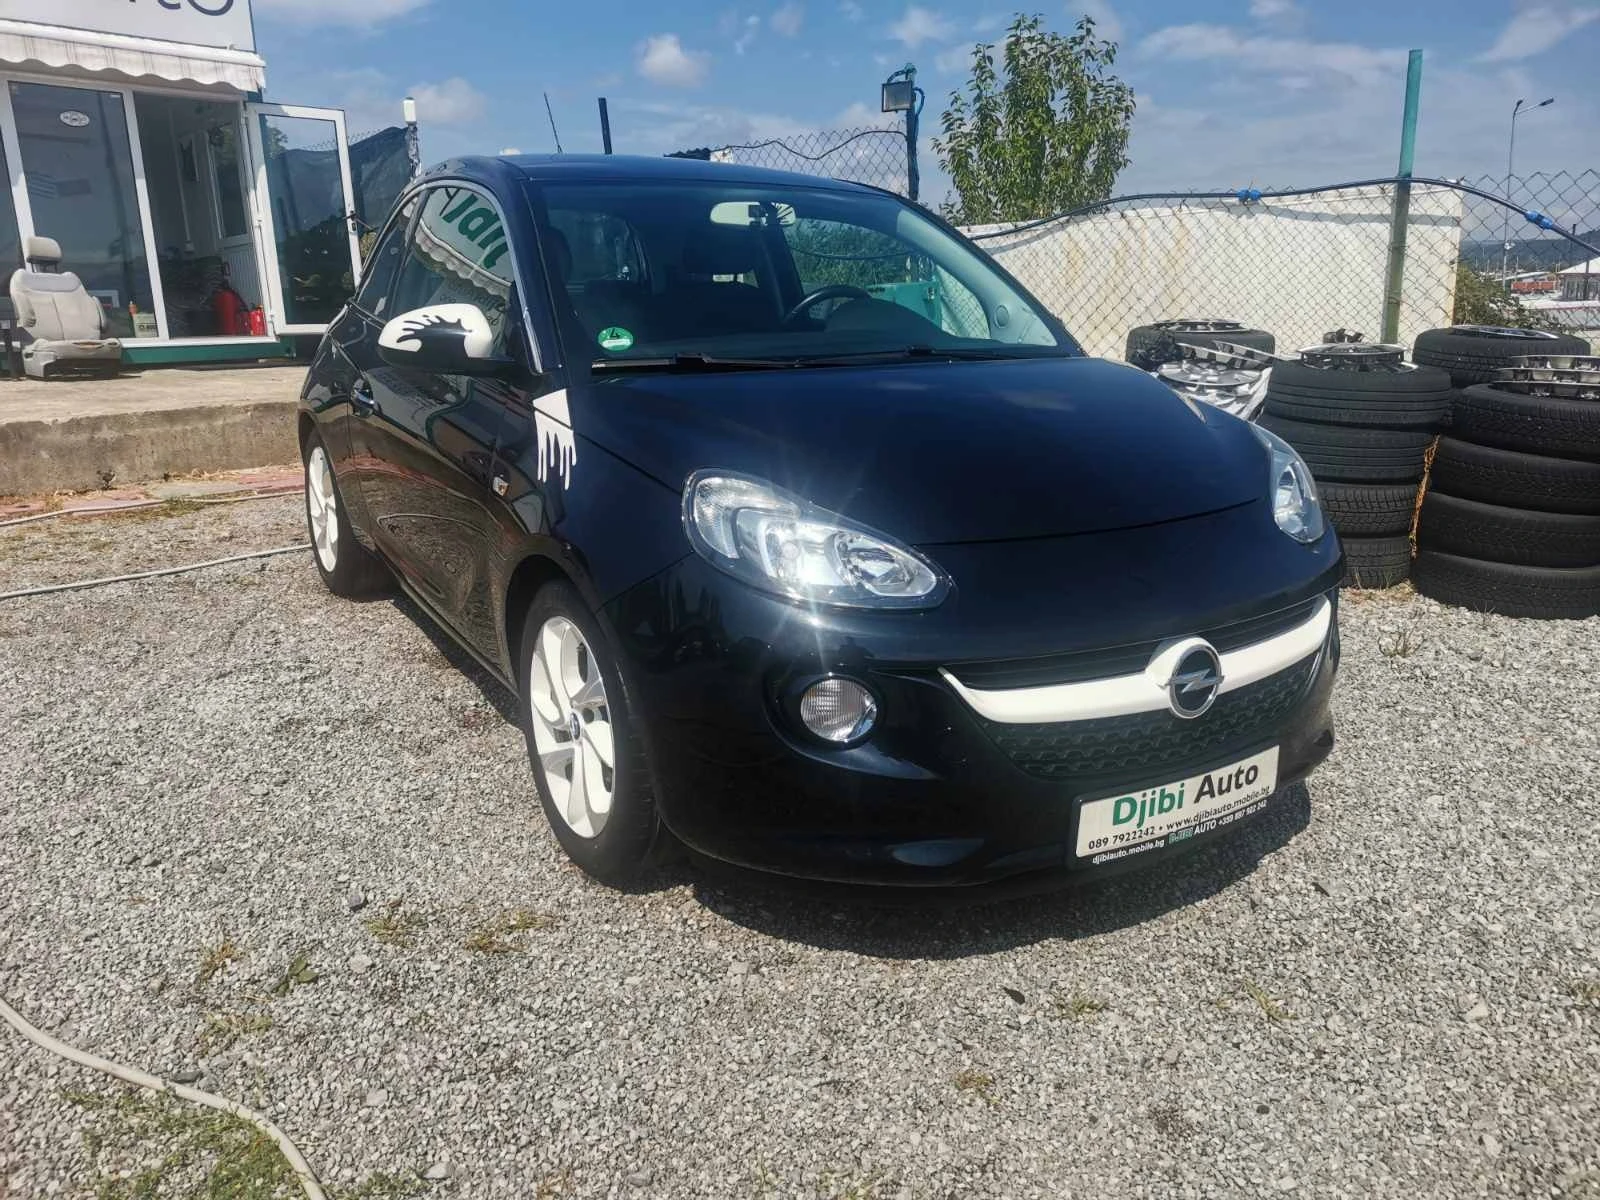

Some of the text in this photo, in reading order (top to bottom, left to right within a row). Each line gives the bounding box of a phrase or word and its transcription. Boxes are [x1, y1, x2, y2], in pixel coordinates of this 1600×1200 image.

[1088, 786, 1270, 850] 089 7922242 www.djibiauto.mobile.bg
[1112, 765, 1259, 829] Djibi Auto
[1194, 819, 1217, 836] AUTO
